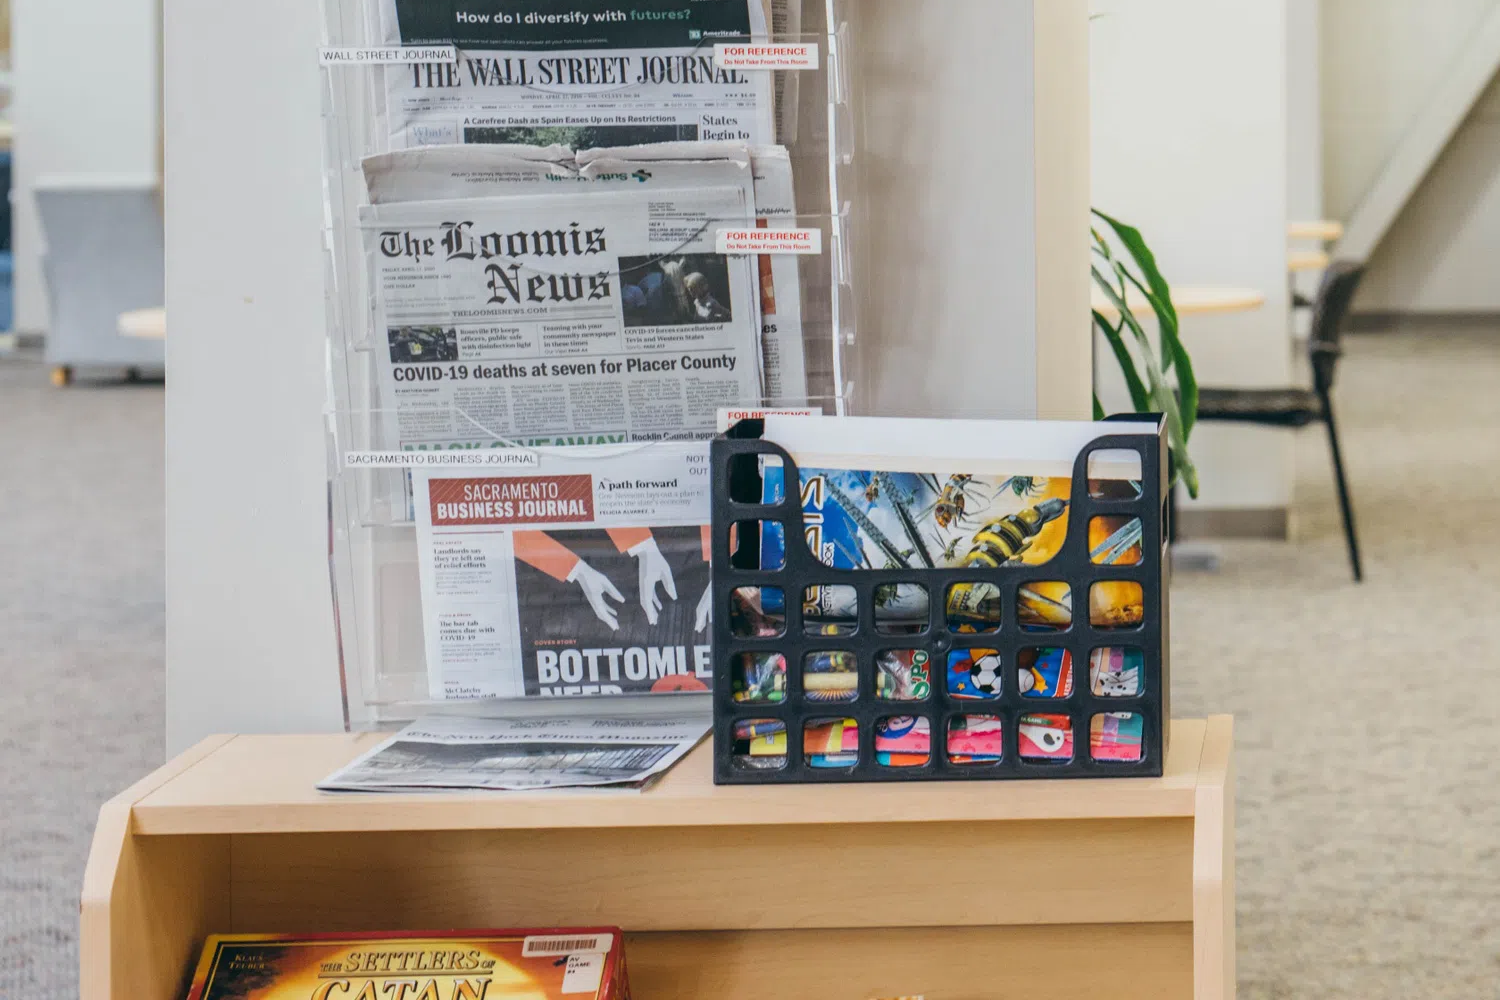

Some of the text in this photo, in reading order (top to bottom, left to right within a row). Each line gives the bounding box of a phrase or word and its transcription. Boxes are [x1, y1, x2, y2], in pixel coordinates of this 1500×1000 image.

[456, 8, 691, 25] How do I diversify with futures?
[702, 29, 741, 37] Ameritrade
[322, 50, 454, 61] WALL STREET JOURNAL
[724, 47, 807, 56] FOR REFERENCE
[409, 58, 462, 88] THE
[466, 58, 534, 86] WALL
[537, 56, 630, 86] STREET
[471, 117, 506, 125] Carefree
[508, 117, 529, 125] Dash
[541, 117, 564, 126] Spain
[590, 116, 601, 125] Up
[628, 115, 676, 123] Restrictions
[703, 114, 738, 125] States
[412, 126, 452, 138] What's
[703, 128, 750, 141] Begin to
[726, 231, 811, 241] FOR REFERENCE
[380, 231, 435, 263] The
[440, 221, 606, 261] Loomis
[485, 263, 611, 304] News
[452, 307, 548, 317] THELOOMISNEWS.COM
[543, 324, 570, 333] Teaming
[588, 324, 603, 332] your
[624, 328, 655, 336] COVID-19
[676, 325, 716, 334] cancellation
[460, 334, 486, 342] officers,
[543, 331, 616, 342] community newspaper
[685, 333, 704, 341] States
[477, 341, 531, 350] disinfection light
[393, 354, 737, 382] COVID-19 deaths at seven for Placer County
[727, 411, 749, 419] FOR
[632, 432, 662, 441] Rocklin
[347, 454, 536, 465] SACRAMENTO BUSINESS JOURNAL
[686, 455, 705, 464] NOT
[689, 467, 708, 475] OUT
[609, 478, 678, 492] path forward
[463, 482, 559, 501] SACRAMENTO
[437, 498, 587, 520] BUSINESS JOURNAL
[234, 953, 264, 961] KLAUS
[320, 950, 496, 973] THE SETTLERS OF
